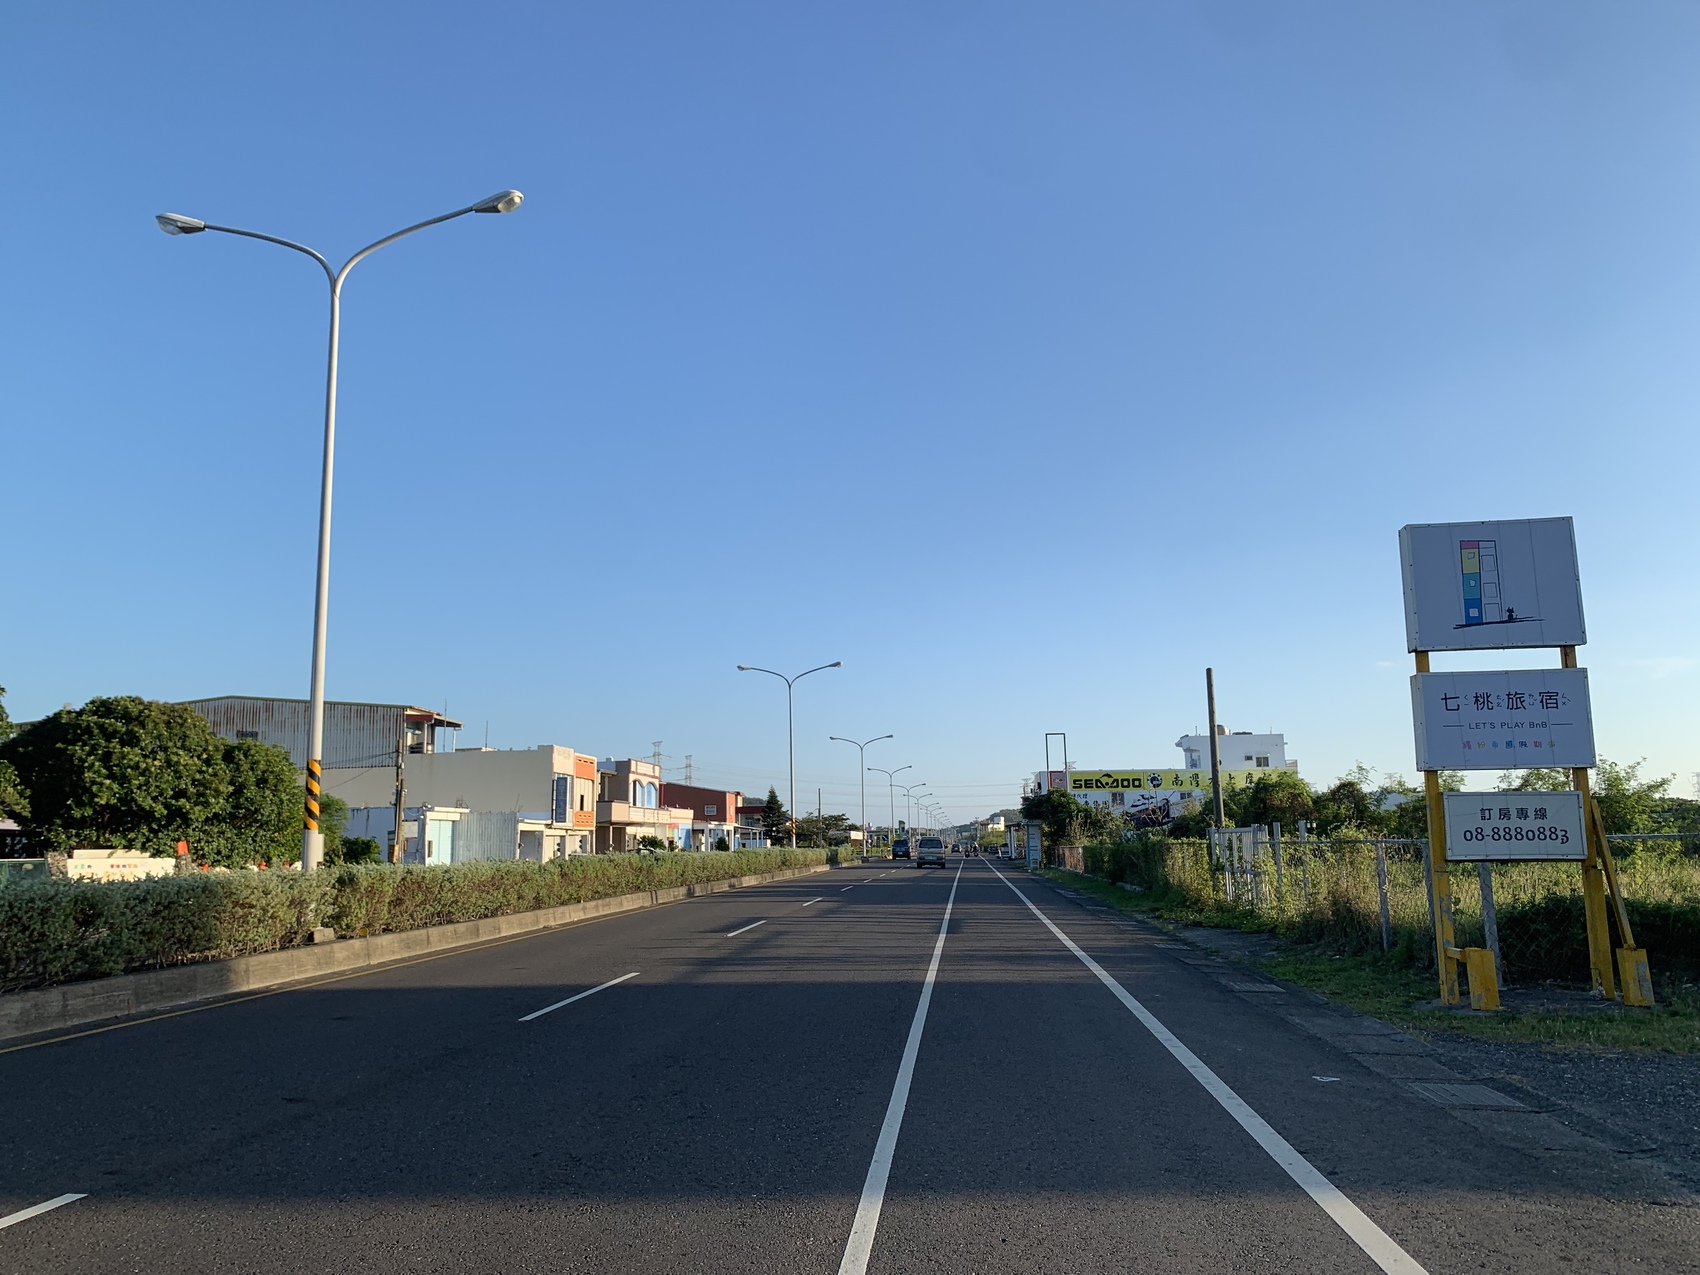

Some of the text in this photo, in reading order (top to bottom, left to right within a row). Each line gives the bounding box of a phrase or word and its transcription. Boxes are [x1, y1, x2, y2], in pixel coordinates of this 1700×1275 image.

[1440, 690, 1559, 712] 七桃旅宿
[1468, 721, 1548, 730] LET'S PLAY BnB
[1479, 807, 1548, 821] 訂房專線
[1463, 826, 1570, 845] 08-8880883
